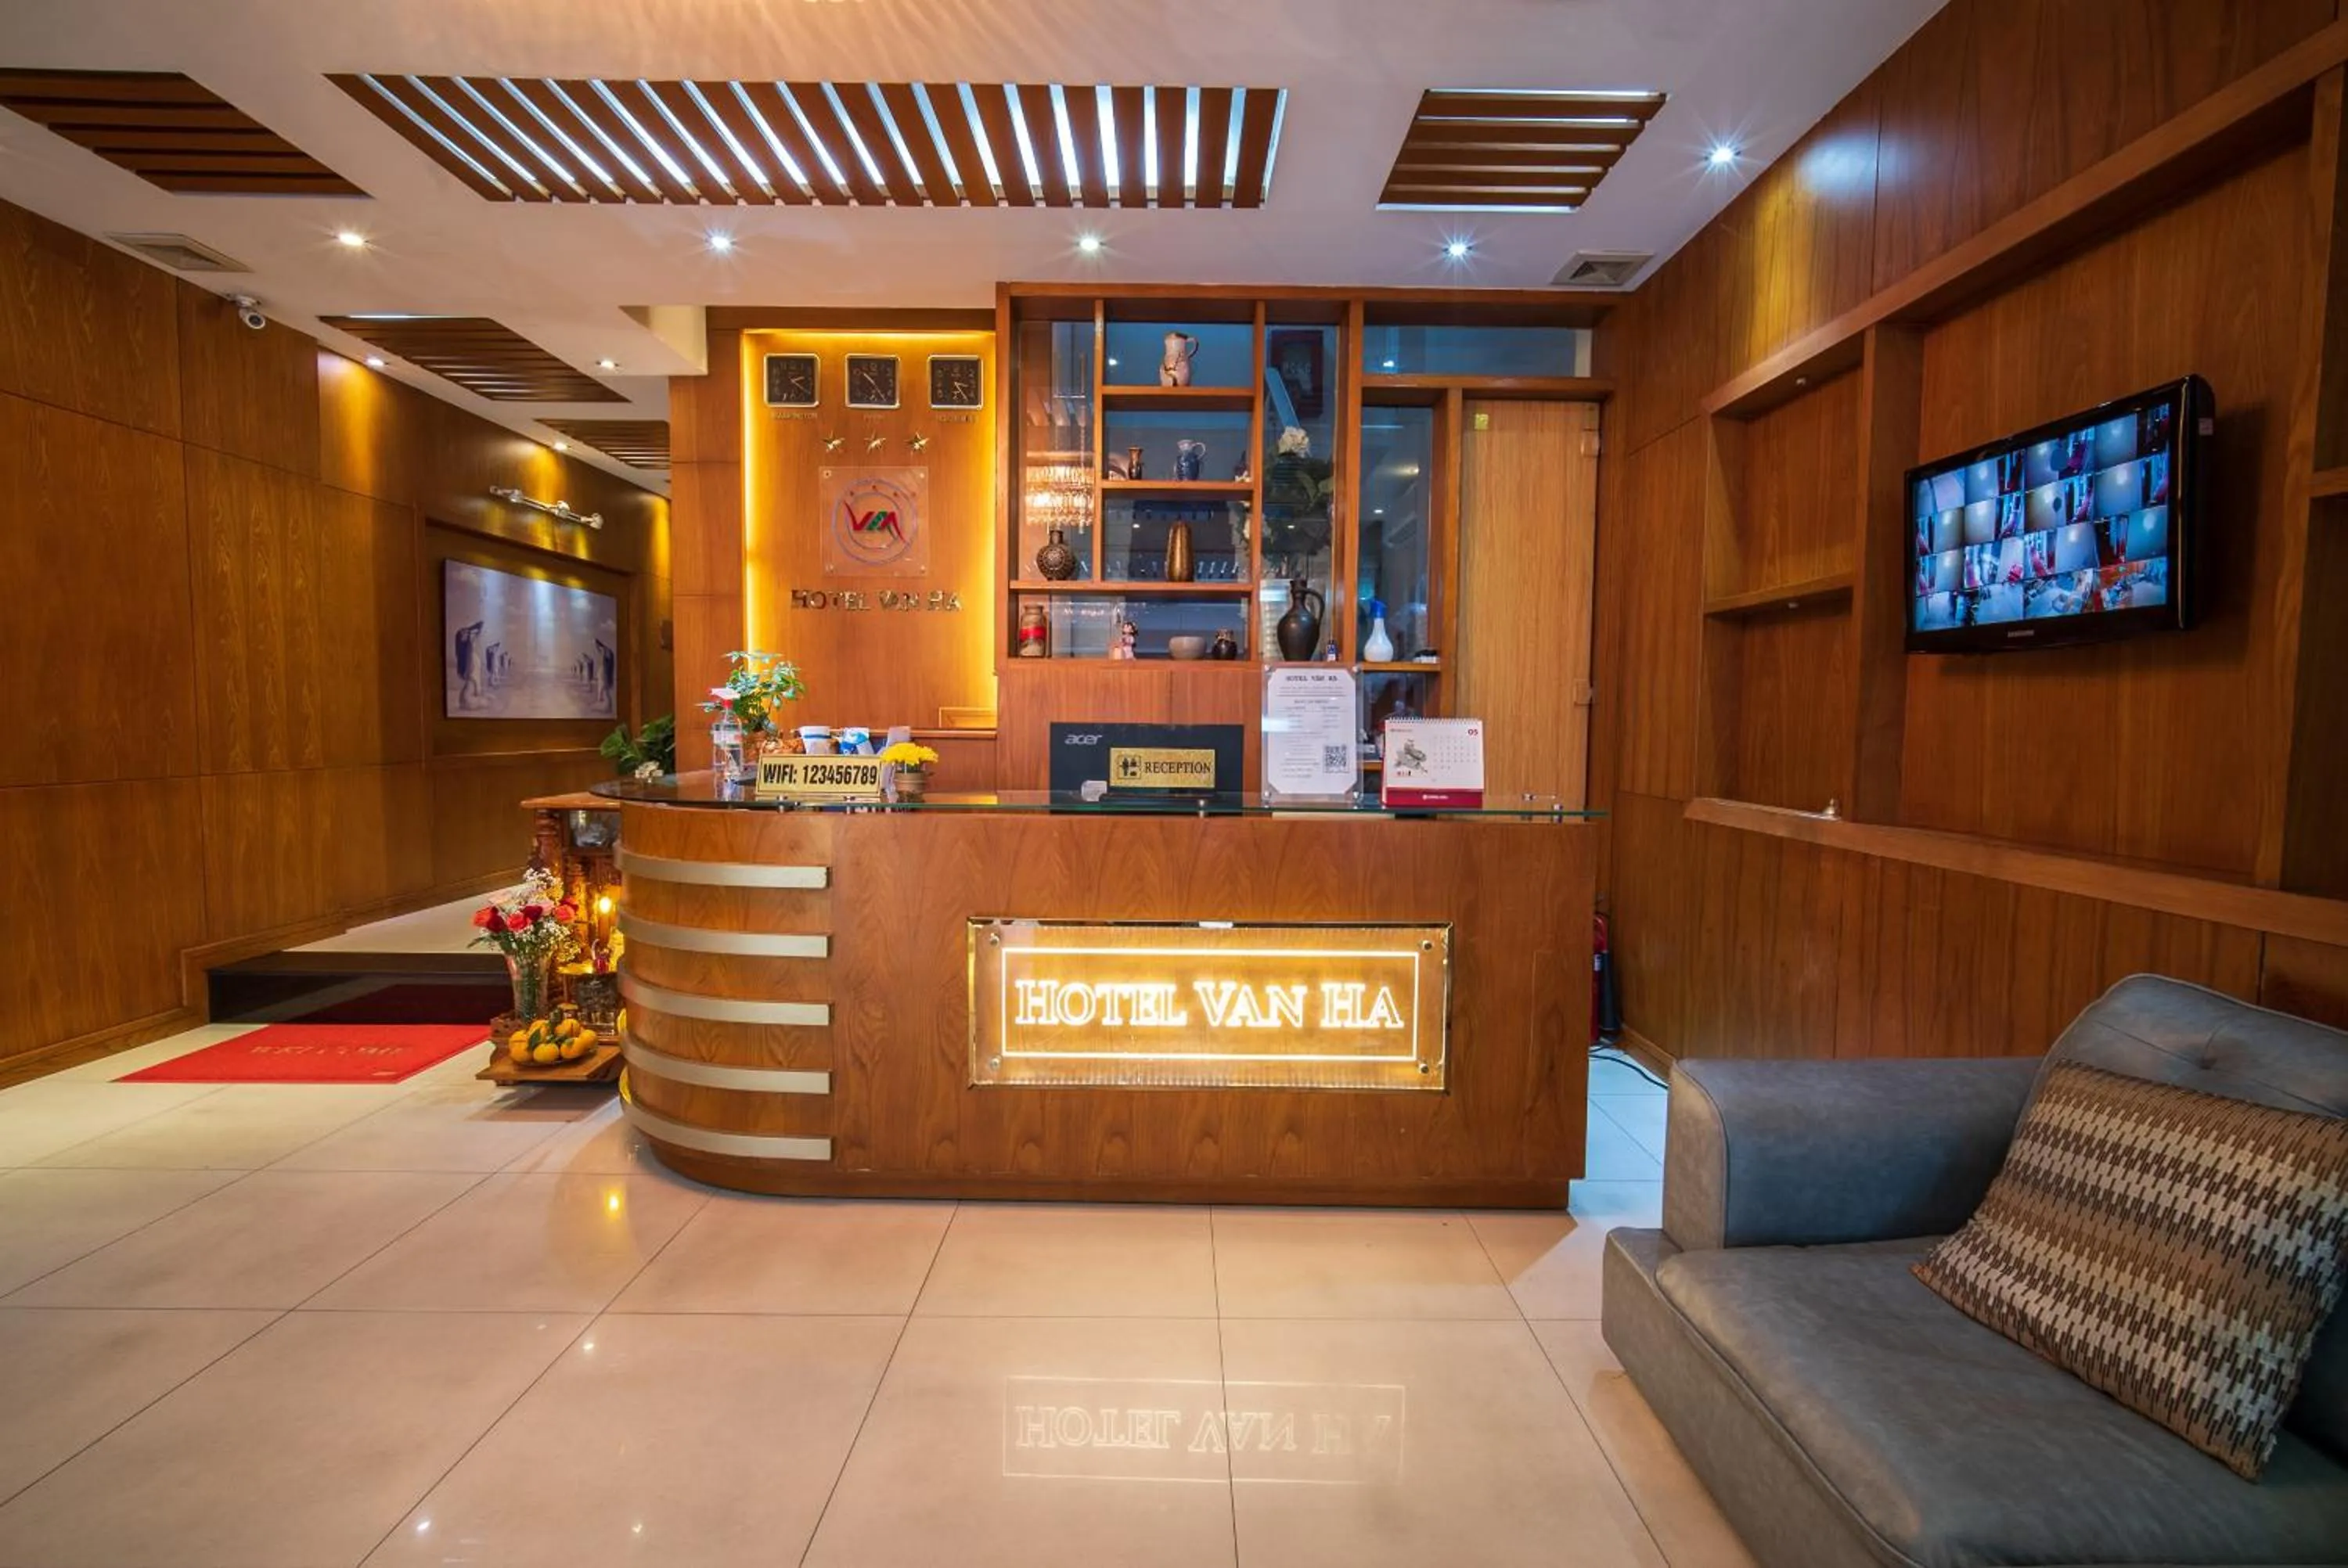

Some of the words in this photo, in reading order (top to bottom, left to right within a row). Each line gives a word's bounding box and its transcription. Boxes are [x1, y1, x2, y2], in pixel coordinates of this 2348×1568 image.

[1064, 734, 1102, 745] acer
[763, 763, 798, 784] WIFI:
[802, 764, 877, 785] 123456789
[1144, 761, 1212, 775] RECEPTION
[1014, 979, 1188, 1027] HOTEL
[1193, 980, 1308, 1028] VAN
[1320, 983, 1404, 1028] HA
